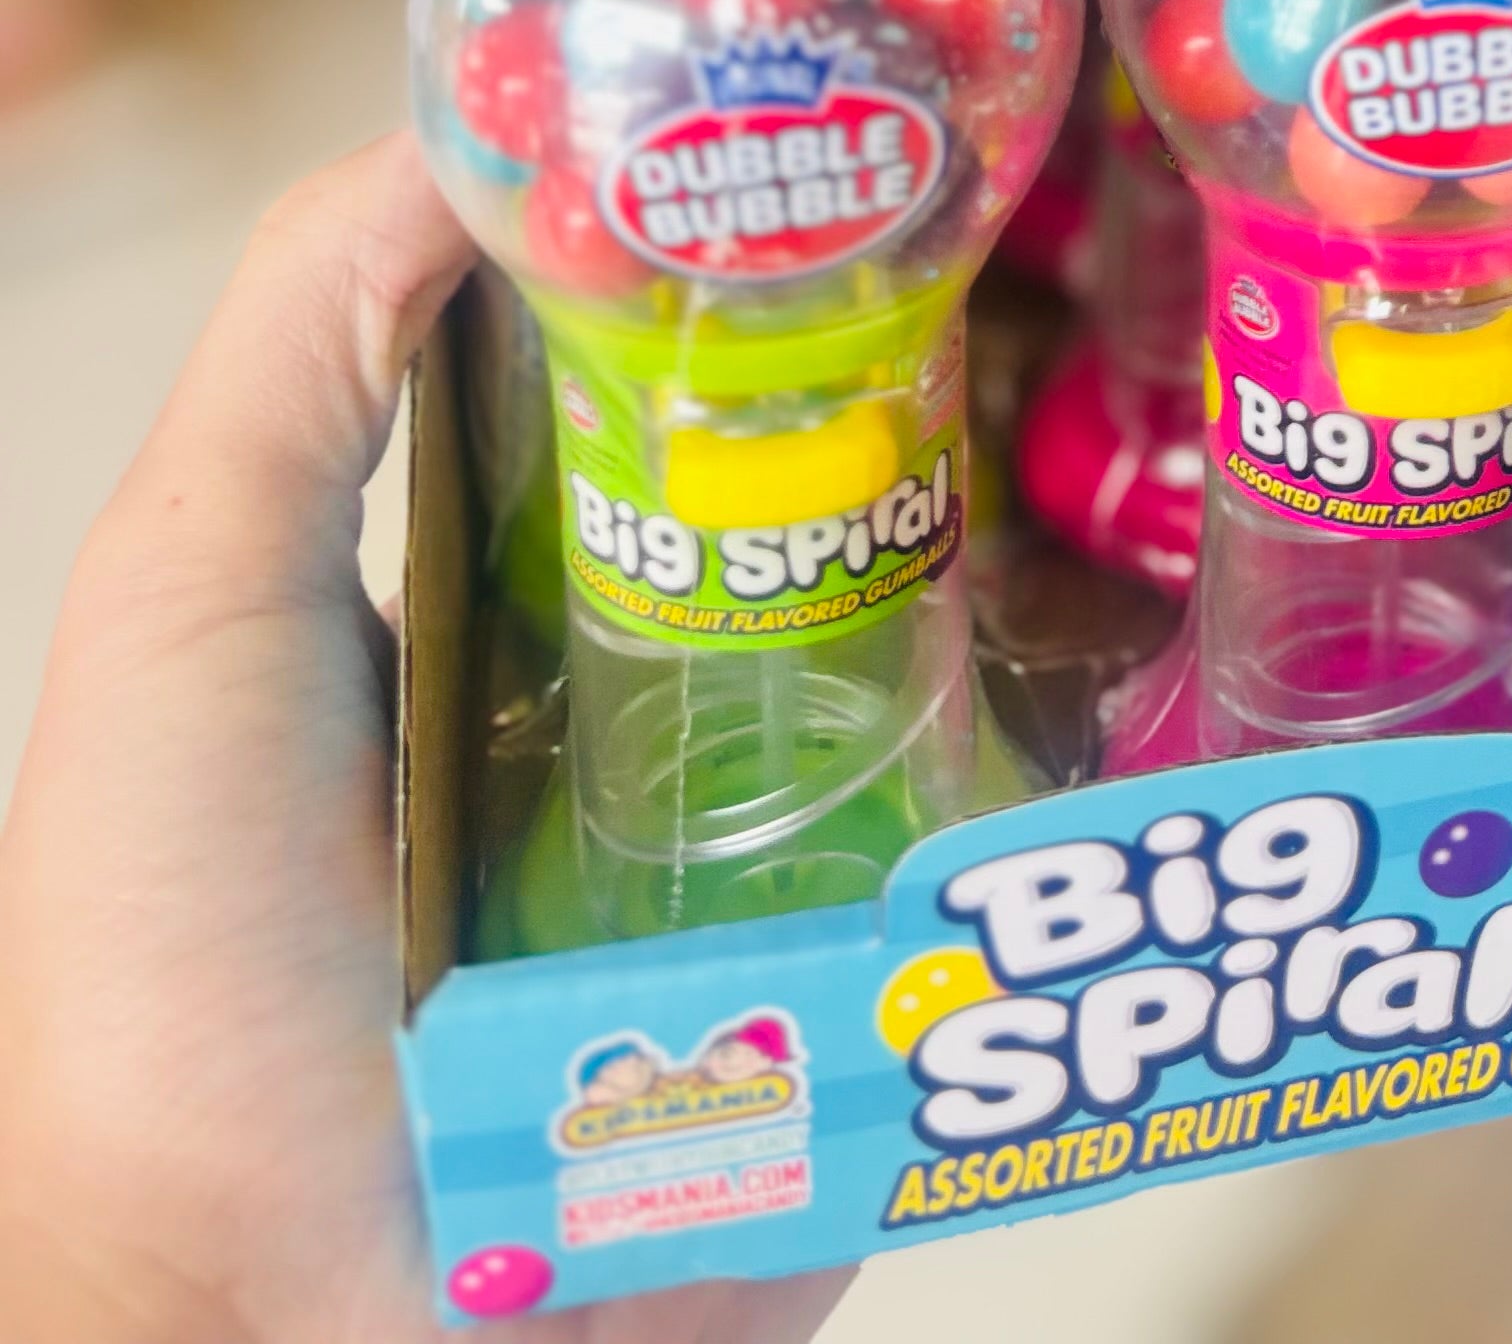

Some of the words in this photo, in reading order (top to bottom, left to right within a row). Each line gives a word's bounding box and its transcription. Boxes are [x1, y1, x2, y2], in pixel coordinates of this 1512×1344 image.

[630, 113, 905, 201] DUBBLE
[642, 162, 915, 249] BUBBLE
[1232, 372, 1374, 493] Big
[569, 469, 704, 597] Big
[1226, 451, 1322, 513] ASSORTED
[1322, 497, 1392, 526] FRUIT
[1396, 486, 1512, 526] FLAVORED
[570, 550, 655, 618] ASSORTED
[655, 601, 729, 632] FRUIT
[730, 592, 861, 633] FLAVORED
[942, 792, 1370, 982] Big
[886, 1120, 1133, 1224] ASSORTED
[1140, 1088, 1271, 1169] FRUIT
[1278, 1038, 1499, 1140] FLAVORED
